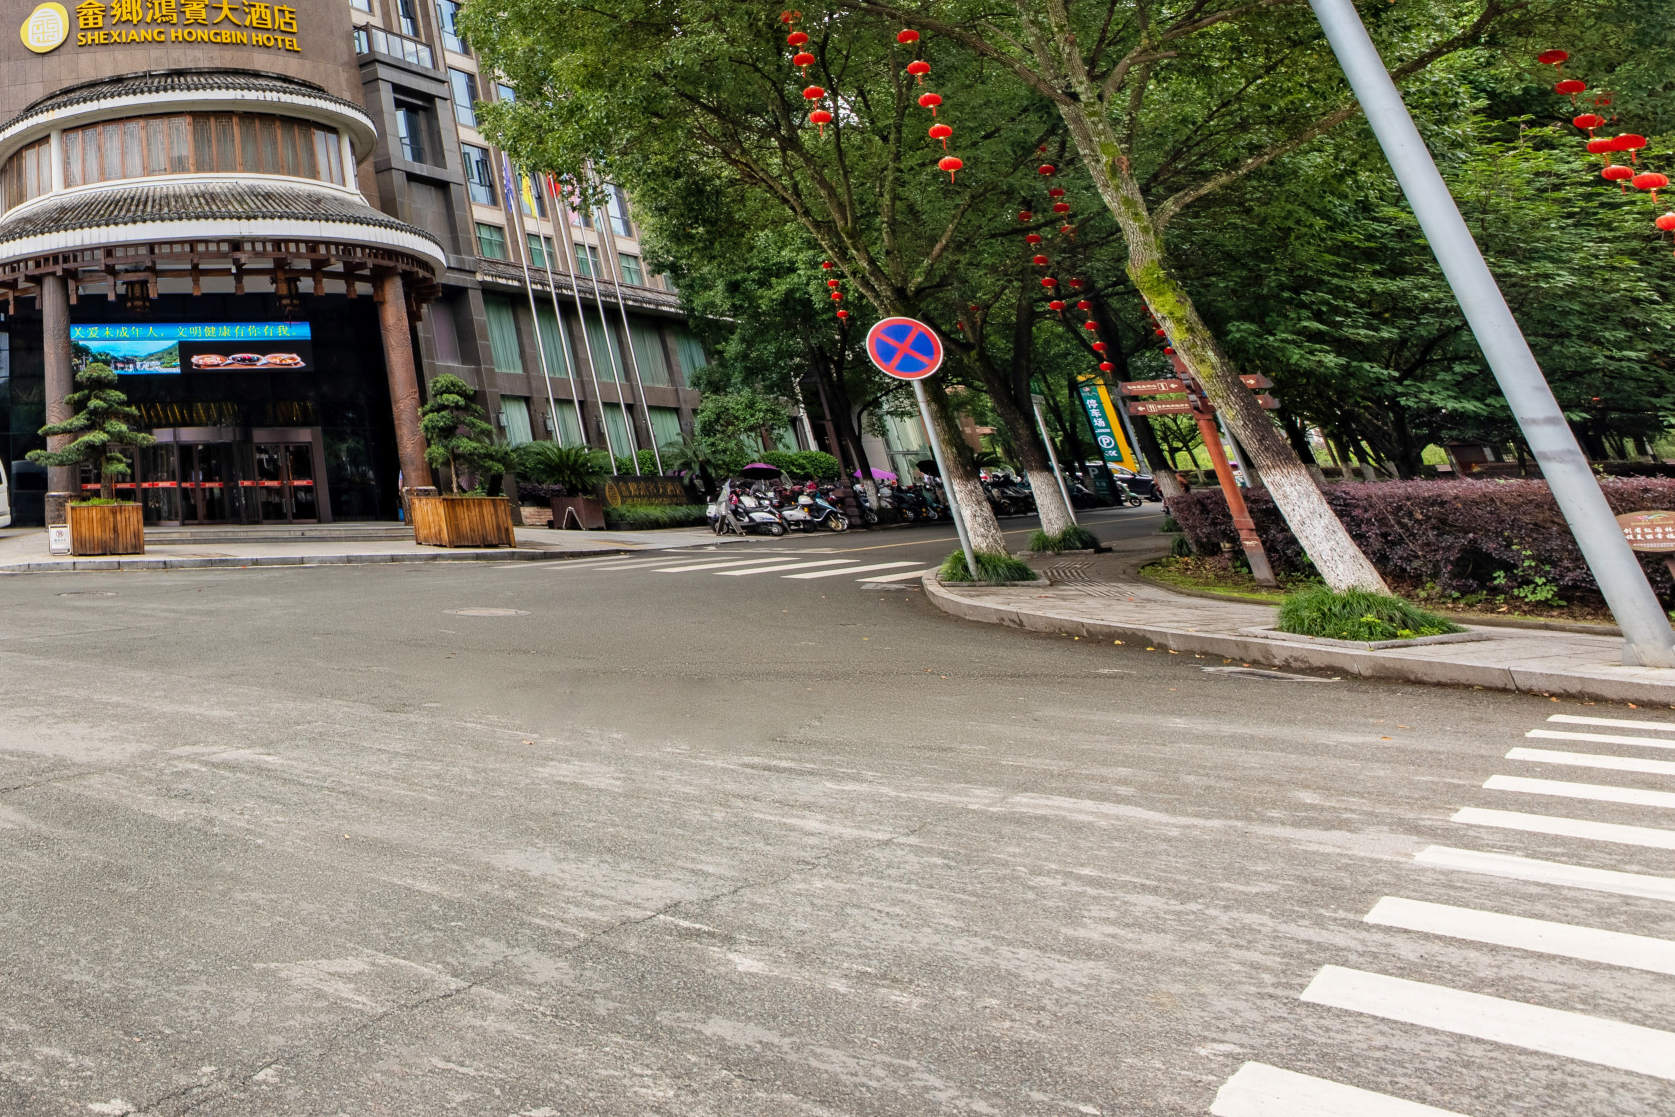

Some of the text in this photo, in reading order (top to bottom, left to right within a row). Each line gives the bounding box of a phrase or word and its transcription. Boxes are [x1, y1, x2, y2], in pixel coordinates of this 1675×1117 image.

[77, 28, 302, 53] SHEXIANG HONGBIN HOTEL
[1086, 398, 1106, 427] 停车场
